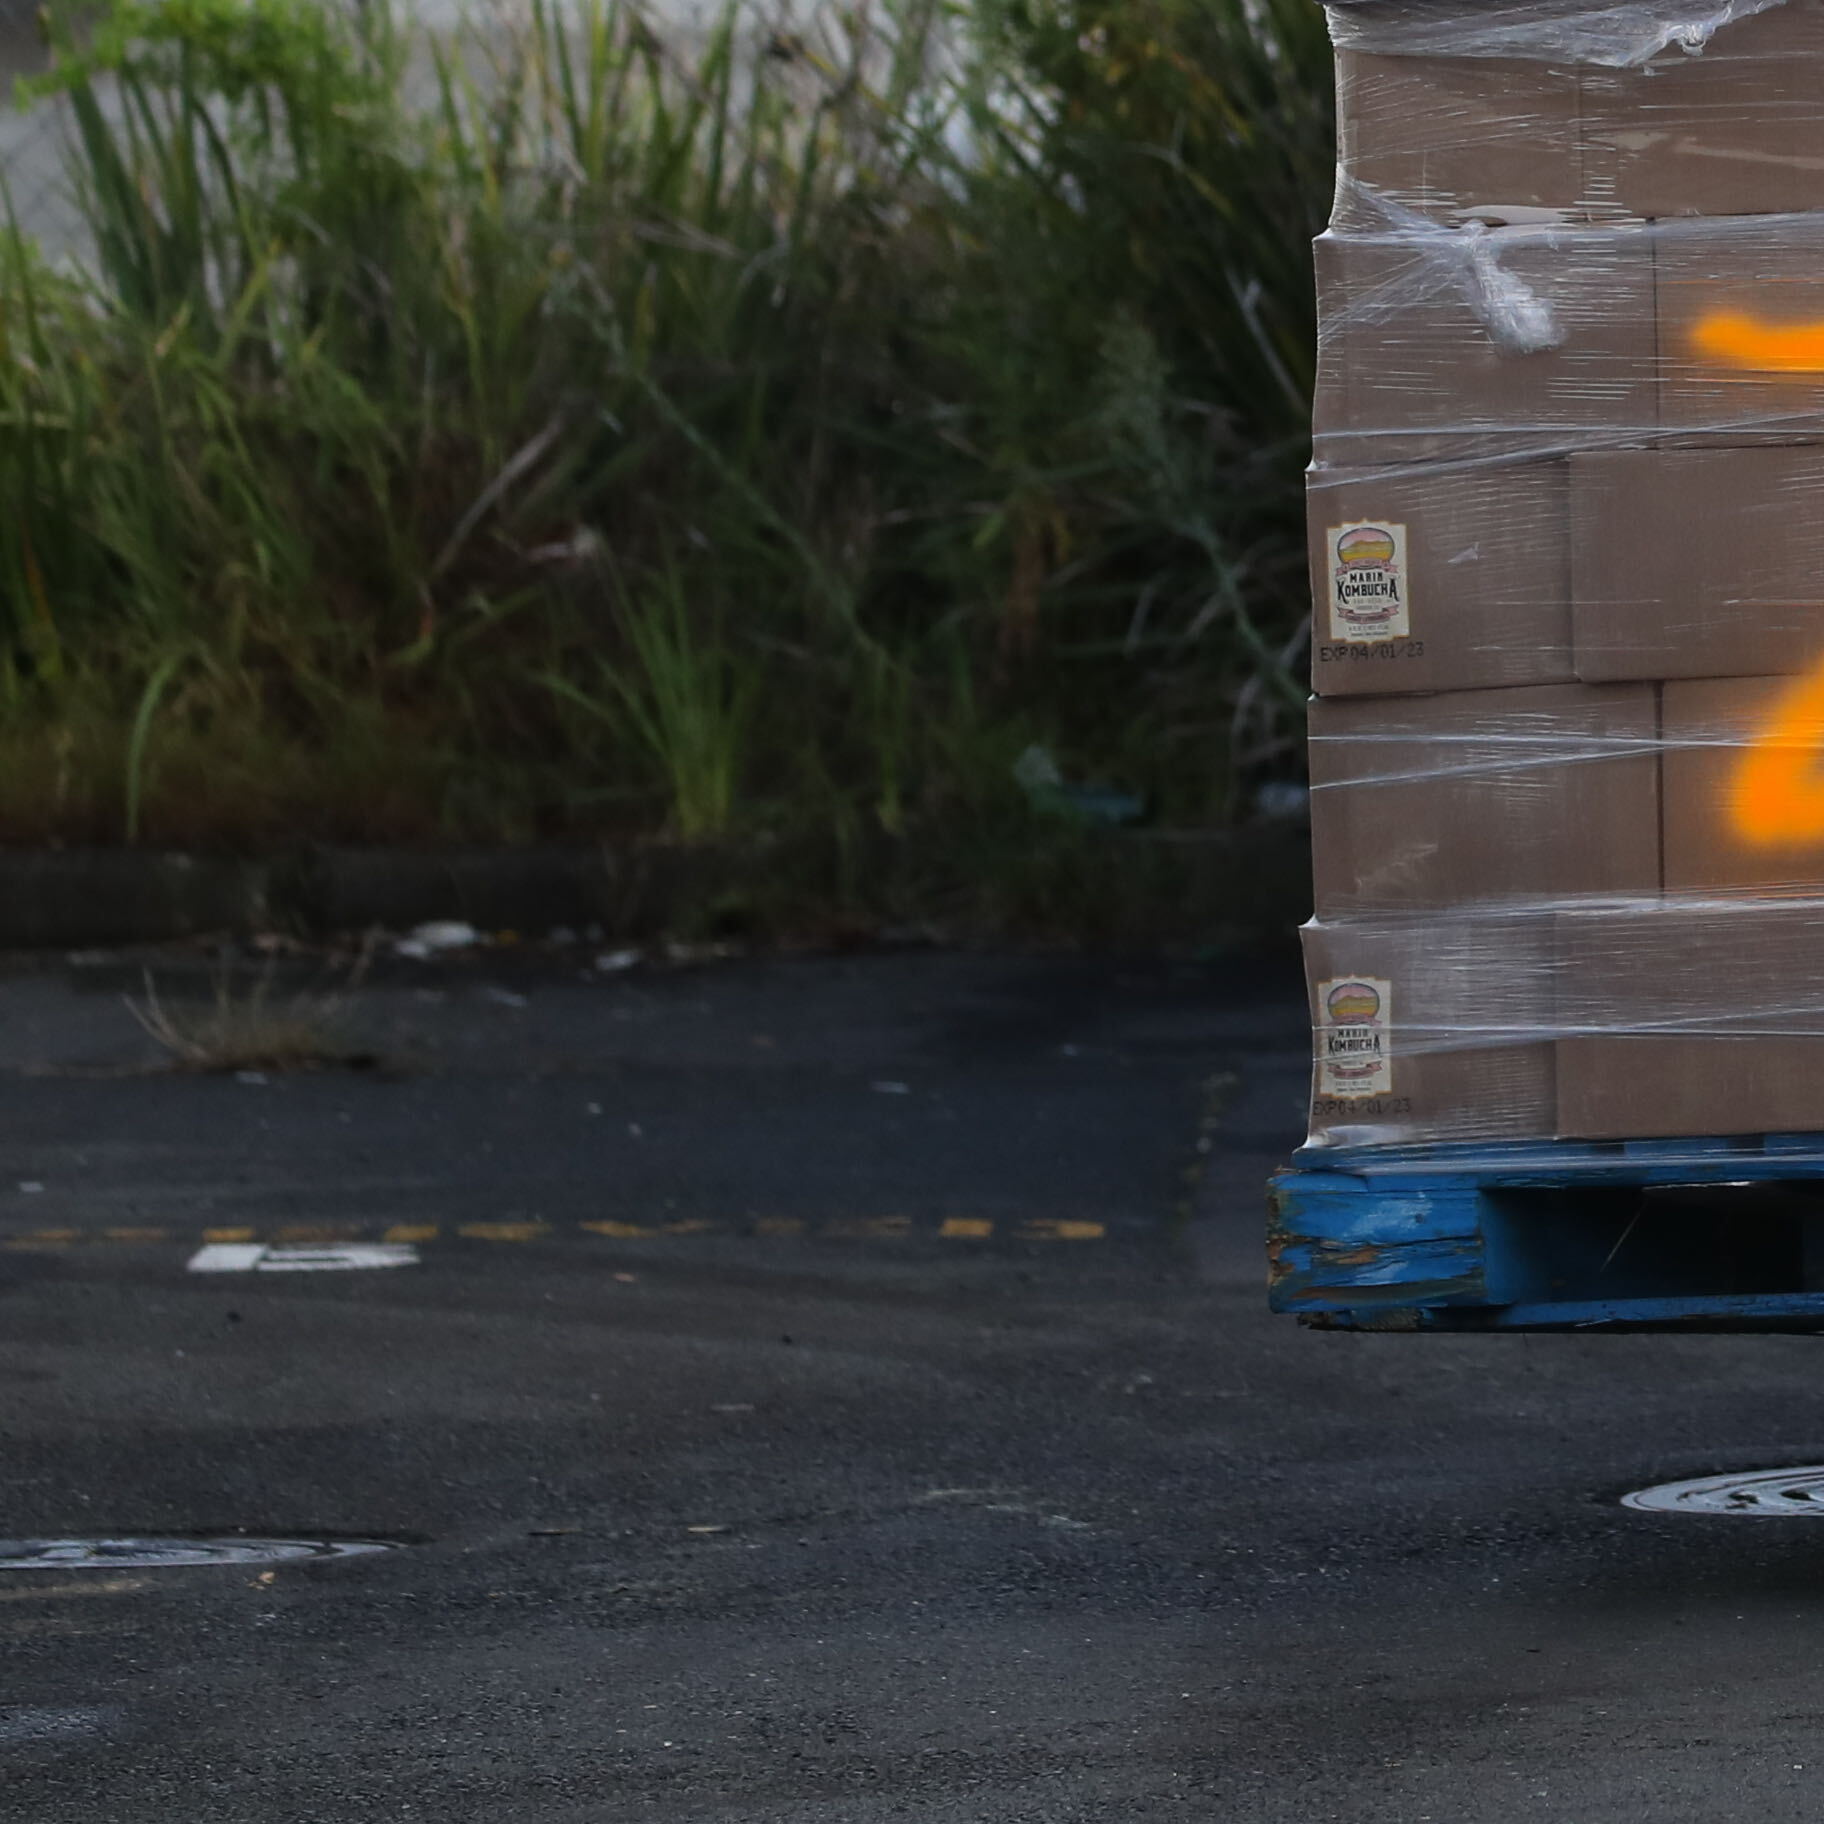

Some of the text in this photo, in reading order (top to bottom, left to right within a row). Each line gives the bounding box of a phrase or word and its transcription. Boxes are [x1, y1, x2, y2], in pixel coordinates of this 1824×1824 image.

[1350, 572, 1383, 583] MARIN
[1337, 578, 1399, 604] KOMBUCHA
[1320, 642, 1425, 662] EXP 04/01/23
[1328, 1034, 1380, 1056] KOMBUCHA
